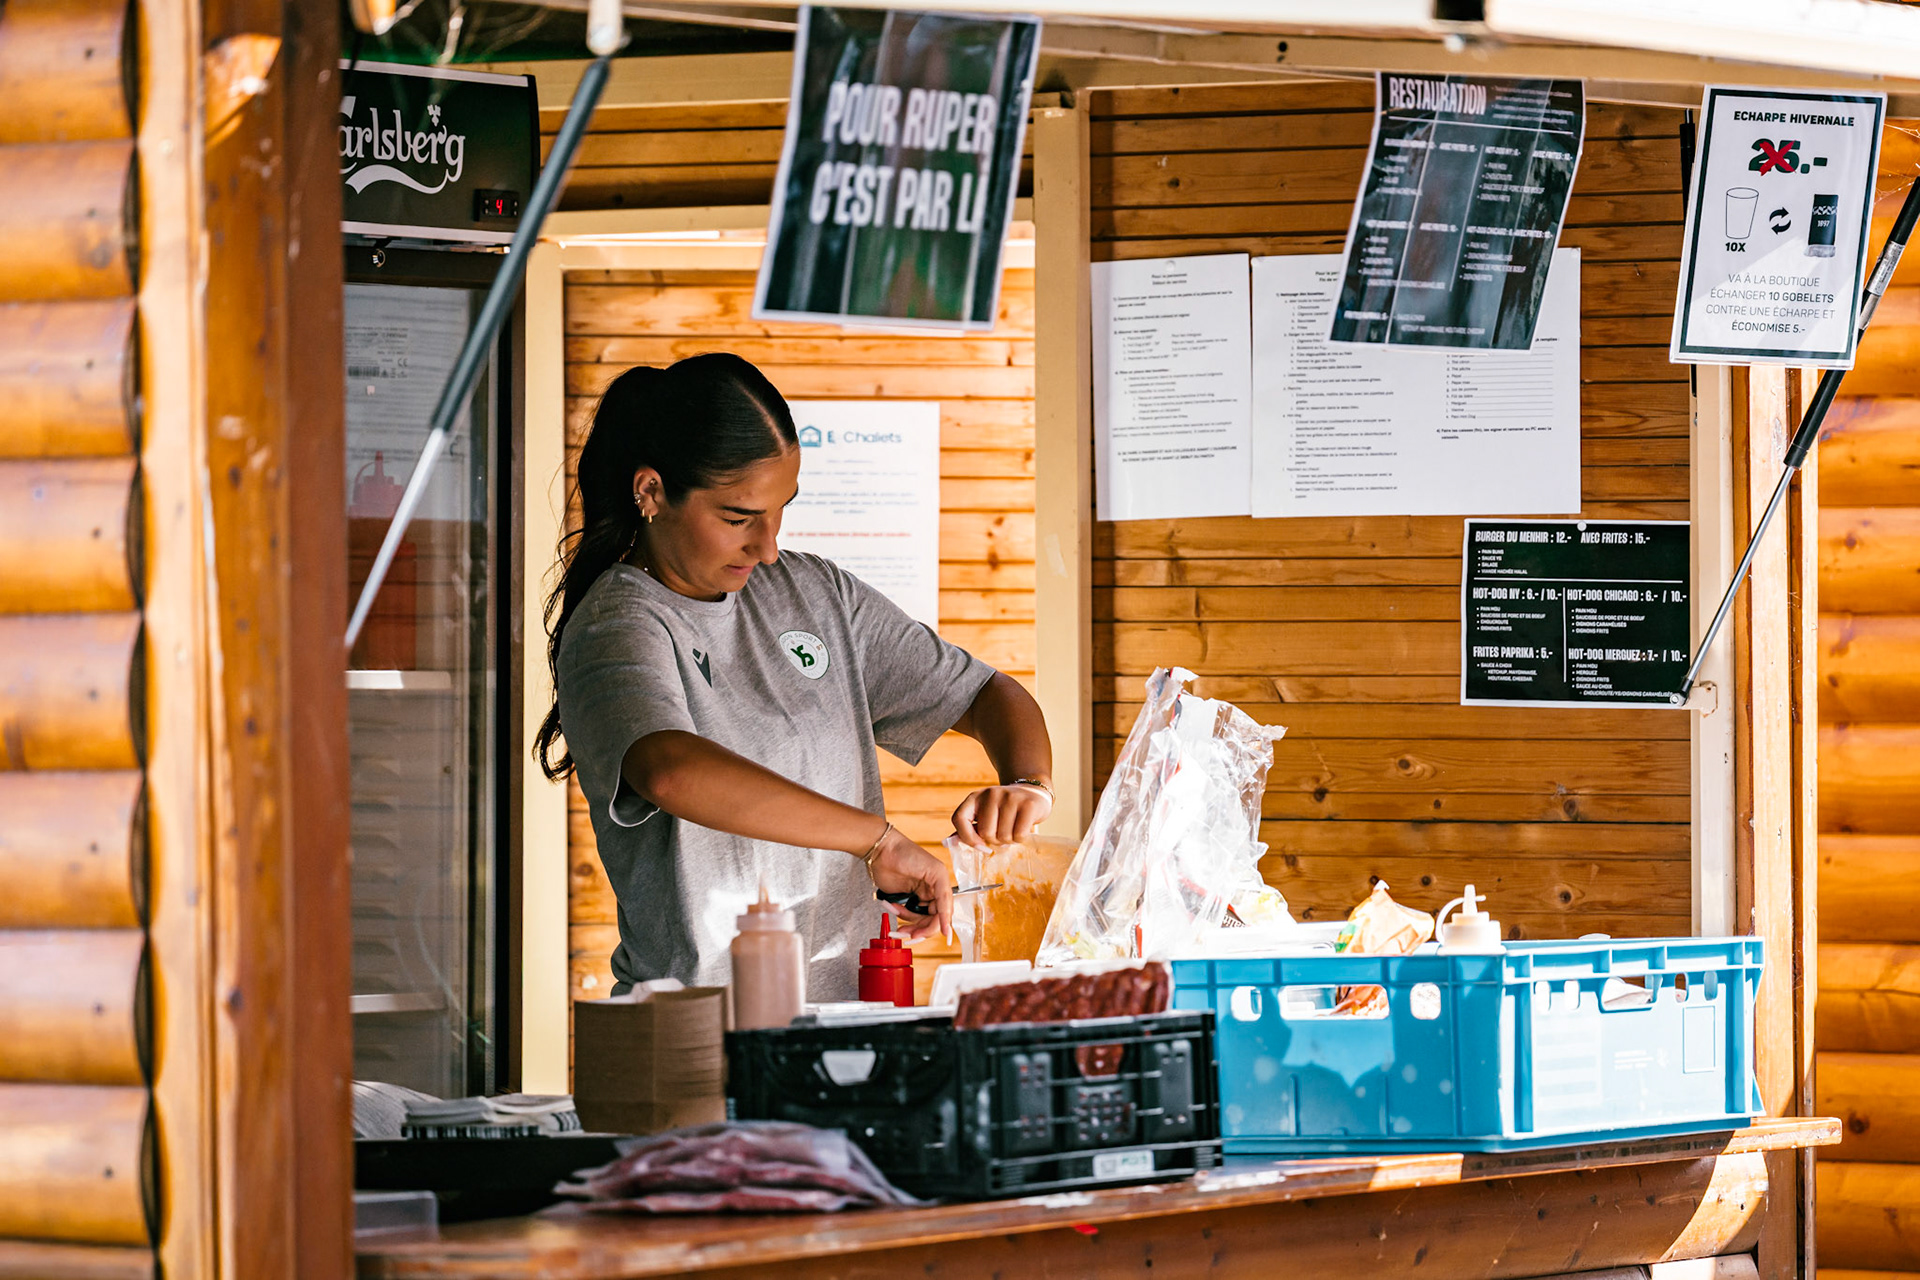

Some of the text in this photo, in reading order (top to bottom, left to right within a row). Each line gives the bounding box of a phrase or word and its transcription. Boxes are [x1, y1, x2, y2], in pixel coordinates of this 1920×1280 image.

[1389, 77, 1487, 115] RESTAURATION
[822, 80, 996, 153] POUR RUPER
[1734, 110, 1855, 127] ECHARPE HIVERNALE
[340, 96, 465, 182] arlsberg
[809, 160, 895, 228] C'EST
[894, 167, 953, 232] PAR
[495, 199, 503, 214] 4
[1725, 242, 1746, 253] 10X
[1728, 272, 1820, 287] VA À LA BOUTIQUE
[1710, 287, 1834, 304] ÉCHANGER 10 GOBELETS
[1706, 304, 1835, 319] CONTRE UNE ÉCHARPE ET
[1731, 319, 1806, 334] ÉCONOMISE 5.-
[844, 431, 902, 444] Chalets
[1475, 530, 1505, 543] BURGER
[1506, 531, 1518, 543] DU
[1519, 531, 1549, 543] MENHIR
[1556, 532, 1572, 543] 12.-
[1580, 532, 1600, 544] AVEC
[1602, 532, 1628, 544] FRITES
[1634, 533, 1650, 544] 15.-
[1472, 587, 1508, 600] HOT-DOG
[1509, 588, 1520, 600] NY
[1526, 588, 1539, 600] 6.-
[1546, 589, 1562, 600] 10.-
[1567, 589, 1602, 601] HOT-DOG
[1604, 590, 1639, 602] CHICAGO
[1645, 590, 1658, 602] 6.-
[1671, 590, 1687, 602] 10.-
[1473, 646, 1499, 658] FRITES
[1501, 646, 1534, 658] PAPRIKA
[1540, 647, 1553, 658] 5.-
[1568, 648, 1604, 660] HOT-DOG
[1605, 649, 1640, 660] MERGUEZ
[1648, 650, 1658, 661] 7.-
[1671, 650, 1687, 662] 10.-
